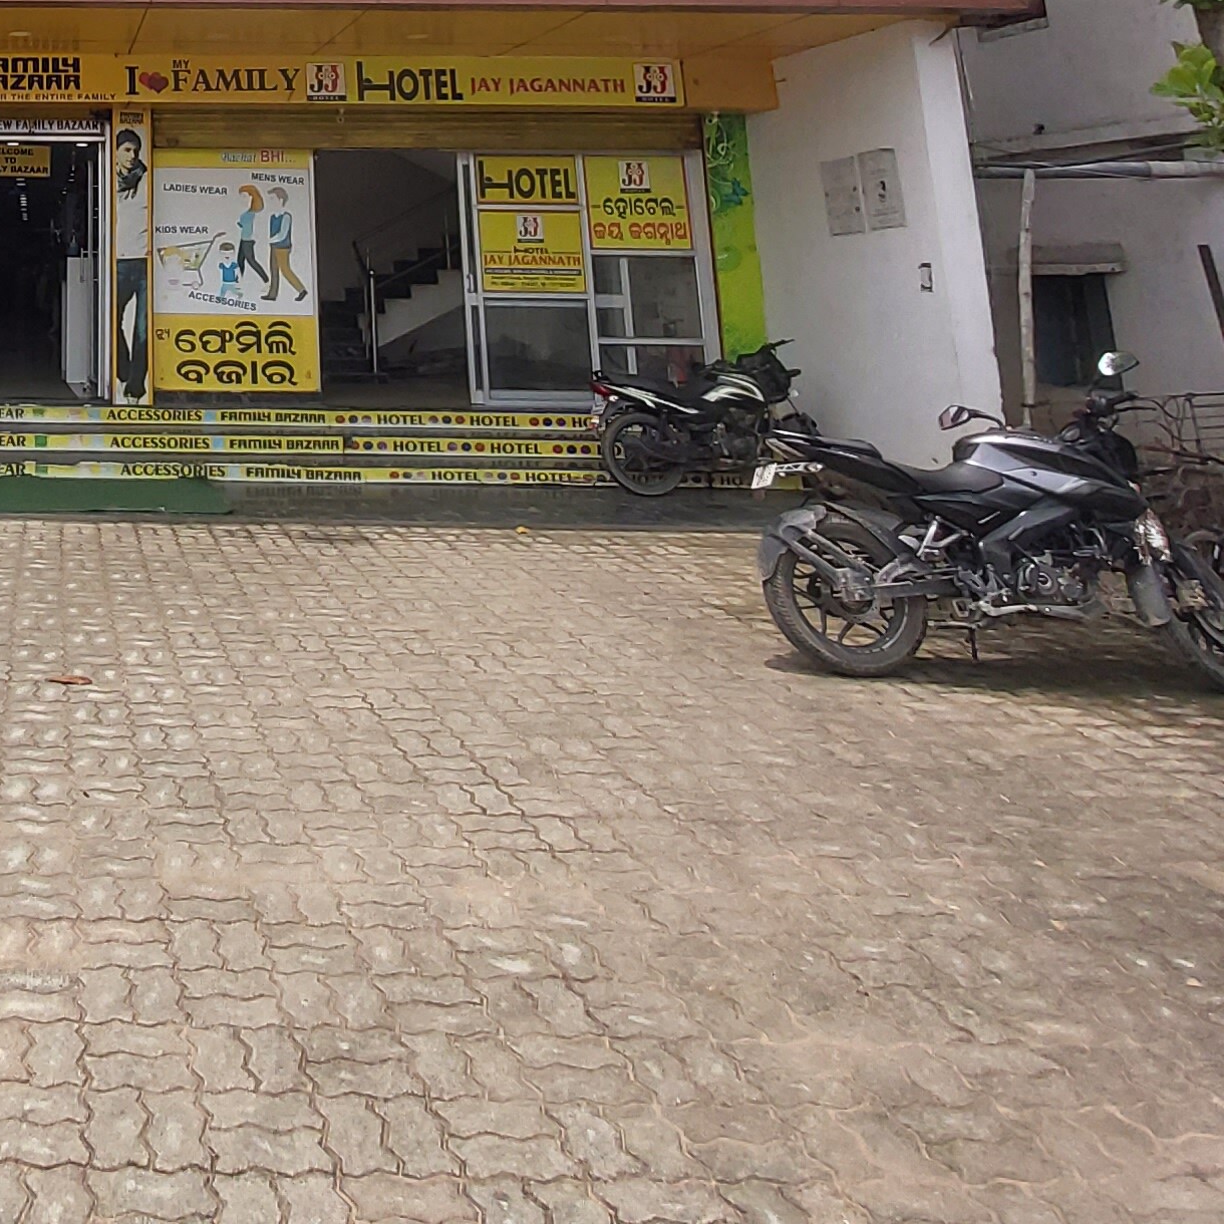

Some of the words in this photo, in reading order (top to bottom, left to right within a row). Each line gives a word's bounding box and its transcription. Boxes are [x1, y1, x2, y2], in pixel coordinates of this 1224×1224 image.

[171, 59, 190, 69] MY
[124, 66, 139, 95] I
[171, 68, 301, 92] FAMILY
[356, 61, 464, 101] HOTEL
[471, 76, 502, 96] JAY
[508, 76, 625, 96] JAGANNATH
[11, 93, 31, 101] THE
[34, 93, 74, 101] ENTIRE
[77, 93, 116, 101] FAMILY
[57, 120, 99, 131] BAZAAR
[10, 165, 49, 174] BAZAAR
[251, 172, 276, 183] MENS
[278, 175, 305, 186] WEAR
[478, 160, 576, 199] HOTEL
[163, 183, 197, 193] LADIES
[199, 186, 227, 195] WEAR
[155, 226, 178, 234] KIDS
[180, 226, 208, 234] WEAR
[484, 254, 506, 266] JAY
[508, 254, 581, 266] JAGANNATH
[188, 290, 257, 311] ACCESSORIES
[176, 359, 298, 386] ବଜାର
[106, 409, 203, 422] ACCESSORIES
[220, 411, 272, 423] FAMILY
[275, 412, 326, 424] BAZAAR
[377, 414, 426, 425] HOTEL
[470, 414, 520, 427] HOTEL
[109, 436, 211, 449] ACCESSORIES
[229, 438, 283, 450] FAMILY
[286, 439, 340, 450] BAZAAR
[393, 440, 445, 453] HOTEL
[489, 442, 543, 455] HOTEL
[120, 464, 226, 477] ACCESSORIES
[245, 466, 302, 479] FAMILY
[305, 469, 362, 481] BAZAAR
[431, 470, 481, 482] HOTEL
